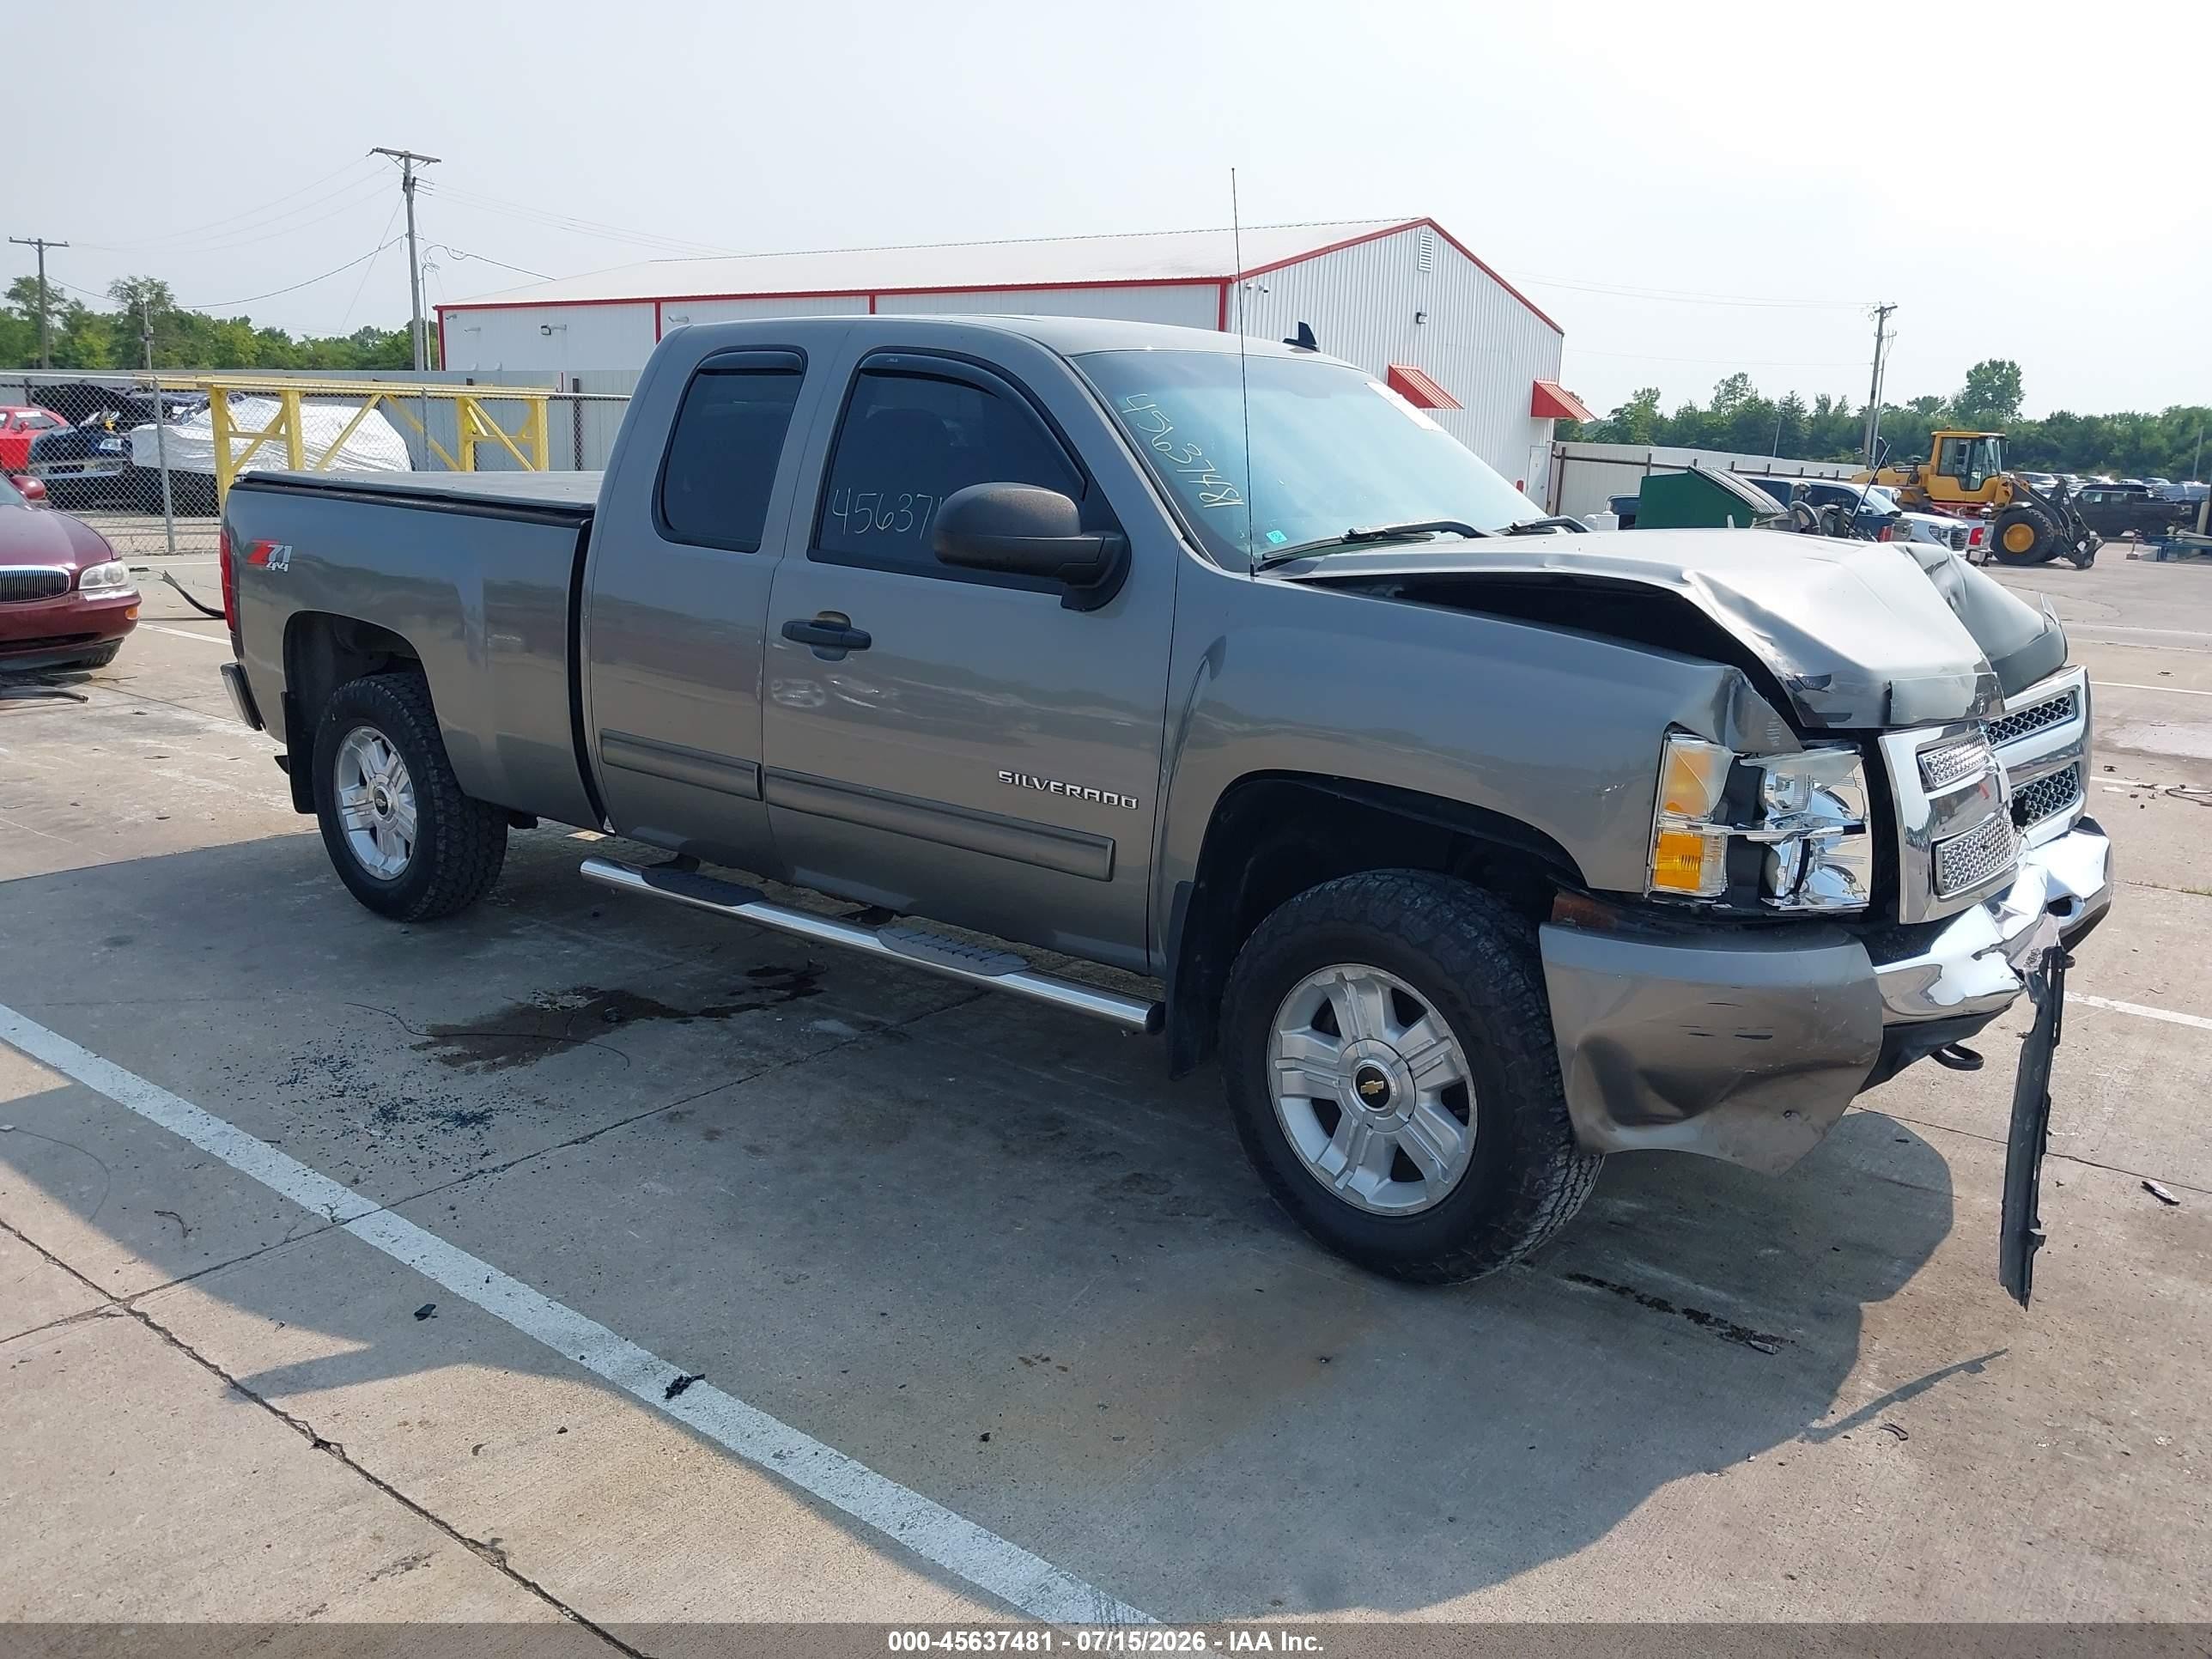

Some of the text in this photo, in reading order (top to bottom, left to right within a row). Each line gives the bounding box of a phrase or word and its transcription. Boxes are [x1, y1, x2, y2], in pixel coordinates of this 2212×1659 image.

[1121, 393, 1244, 509] 45637481
[831, 487, 944, 540] 45637
[247, 539, 293, 562] Z71
[998, 770, 1138, 809] SILVERADO
